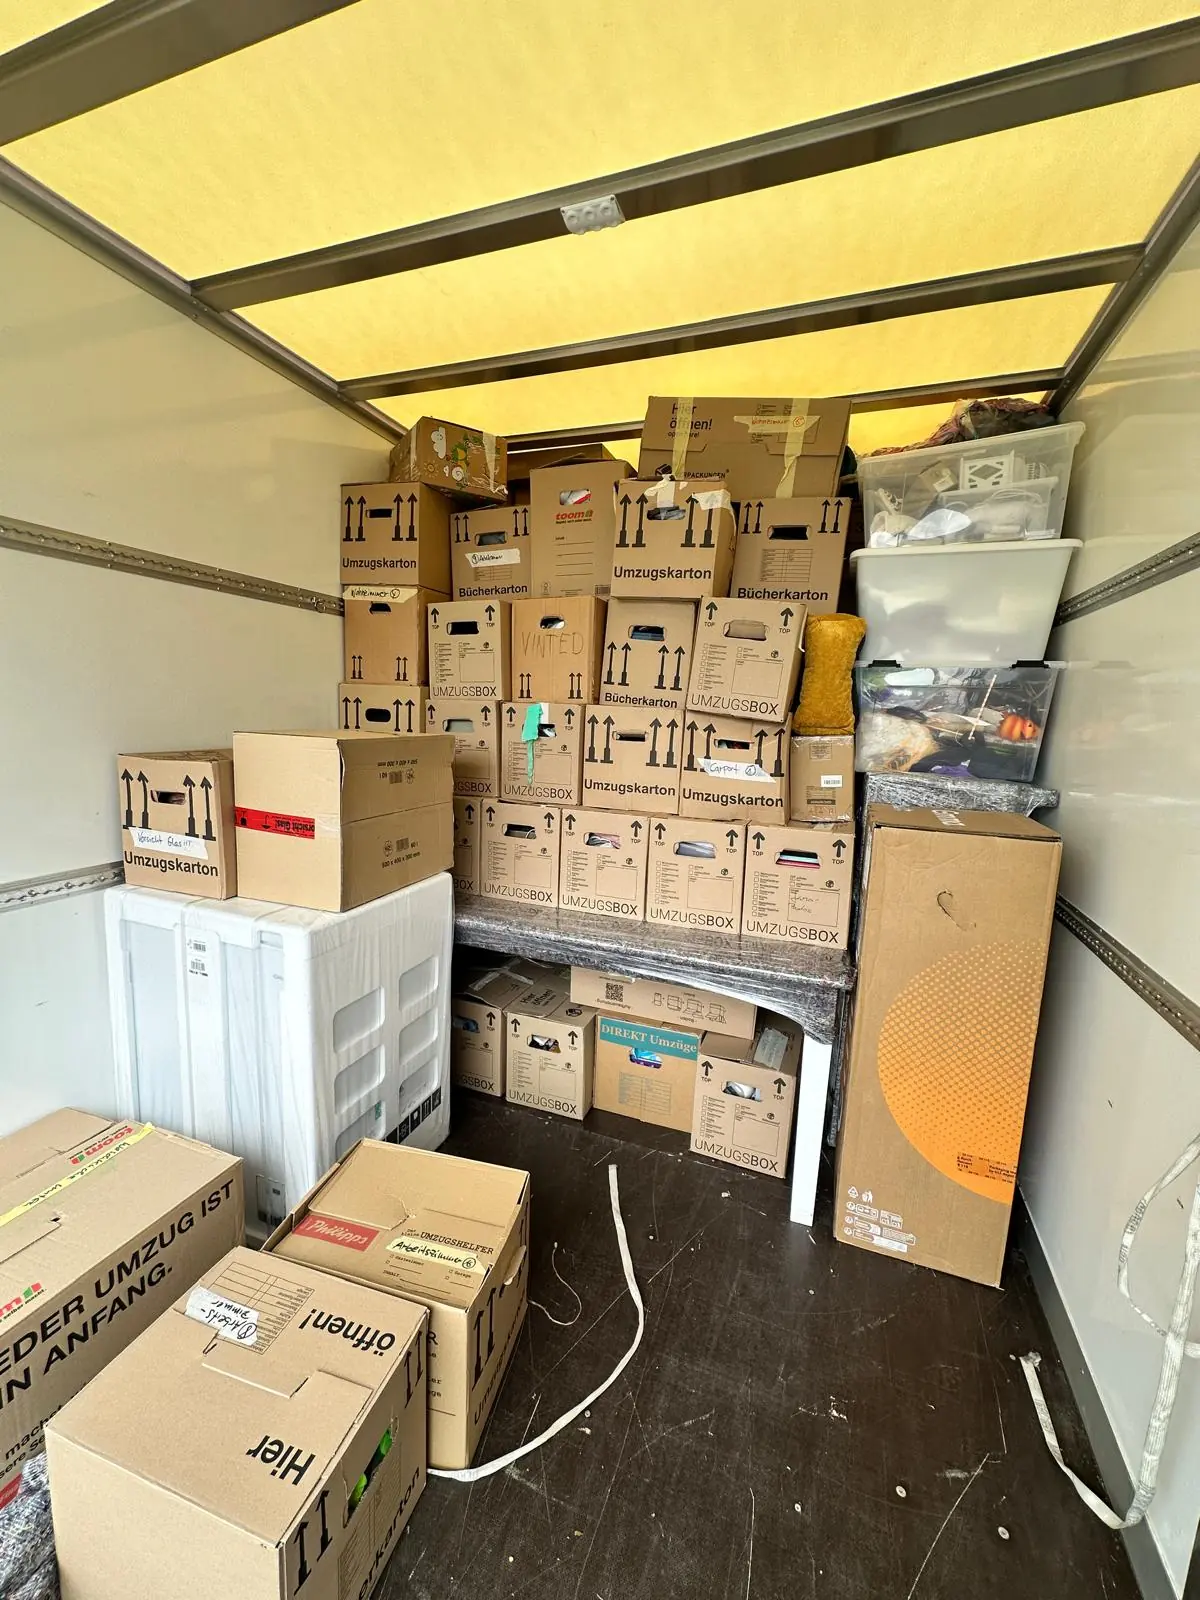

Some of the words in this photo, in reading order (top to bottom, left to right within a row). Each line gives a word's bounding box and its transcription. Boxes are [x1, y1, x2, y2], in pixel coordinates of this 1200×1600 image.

[555, 511, 584, 520] toom
[342, 557, 417, 570] Umzugskarton
[614, 565, 711, 581] Umzugskarton
[459, 584, 528, 597] Bücherkarton
[737, 587, 828, 601] Bücherkarton
[521, 632, 584, 658] VINTED
[433, 686, 497, 697] UMZUGSBOX
[604, 692, 678, 709] Bücherkarton
[691, 693, 779, 715] UMZUGSBOX
[455, 782, 492, 793] GSBOX
[504, 784, 573, 800] UMZUGSBOX
[584, 779, 676, 797] Umzugskarton
[682, 788, 784, 808] Umzugskarton
[291, 821, 315, 834] orsicht
[124, 851, 218, 877] Umzugskarton
[454, 879, 474, 891] BOX
[484, 882, 553, 903] UMZUGSBOX
[562, 894, 638, 916] UMZUGSBOX
[650, 907, 734, 929] UMZUGSBOX
[746, 920, 840, 944] UMZUGSBOX
[601, 1022, 647, 1045] DIREKT
[650, 1034, 697, 1053] Umzüge
[461, 1075, 495, 1092] GSBOX
[509, 1089, 577, 1115] UMZUGSBOX
[773, 1093, 784, 1101] TOP
[85, 1126, 134, 1157] toom
[694, 1139, 778, 1172] UMZUGSBOX
[94, 1211, 195, 1298] UMZUG
[201, 1179, 234, 1218] IST
[420, 1231, 494, 1255] UMZUGSHELFER
[43, 1261, 173, 1375] ANFANG.
[299, 1307, 396, 1357] öffnen!
[245, 1435, 316, 1485] Hier
